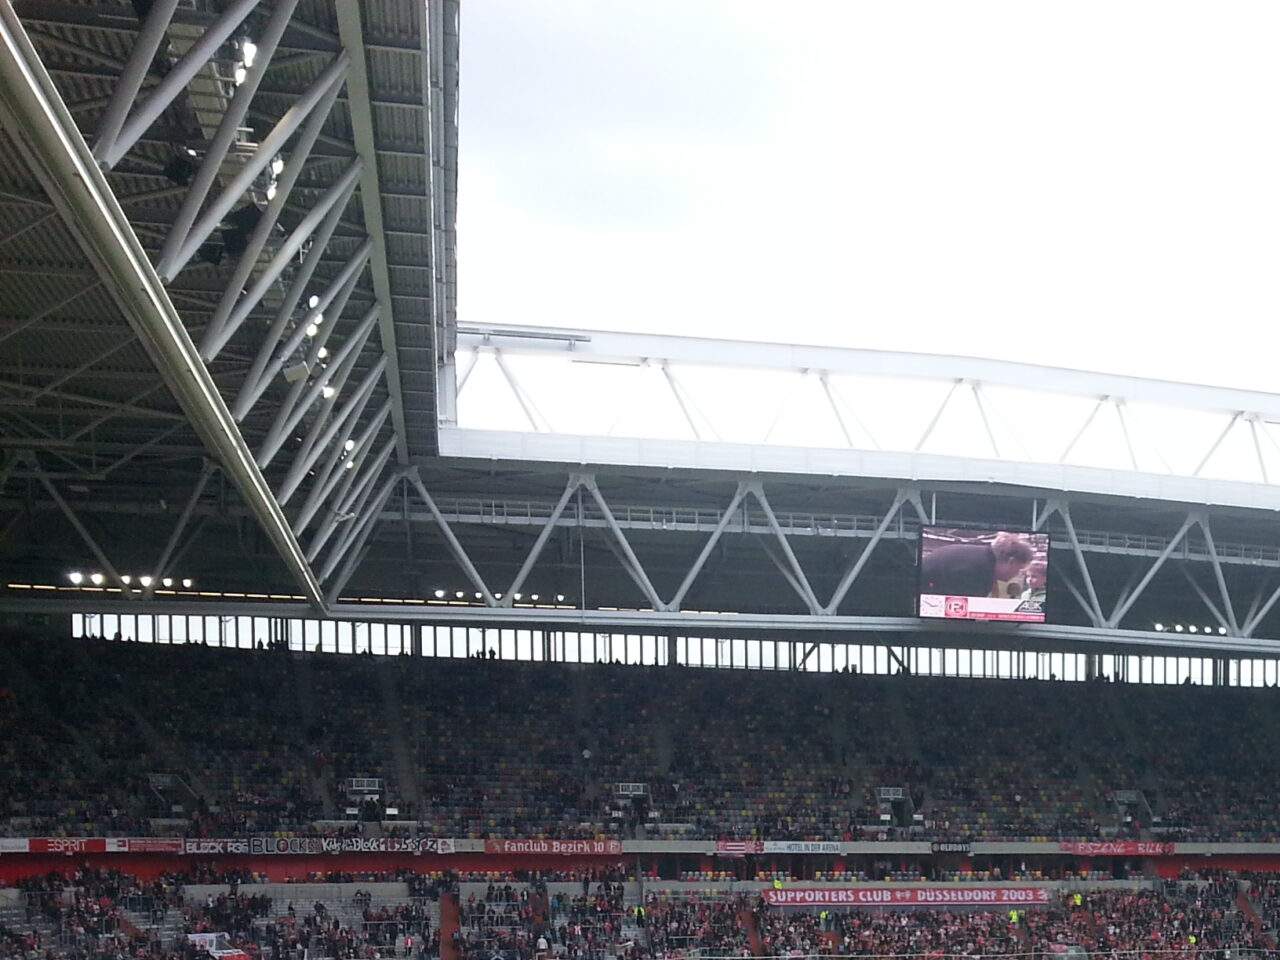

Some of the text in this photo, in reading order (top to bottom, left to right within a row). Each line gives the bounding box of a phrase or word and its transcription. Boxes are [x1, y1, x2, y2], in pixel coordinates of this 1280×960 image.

[47, 839, 87, 852] ESPRIT
[552, 840, 590, 853] Bezirk
[594, 841, 604, 852] 10
[768, 888, 1034, 902] SUPPORTERS CLUB DÜSSELDORF 2003
